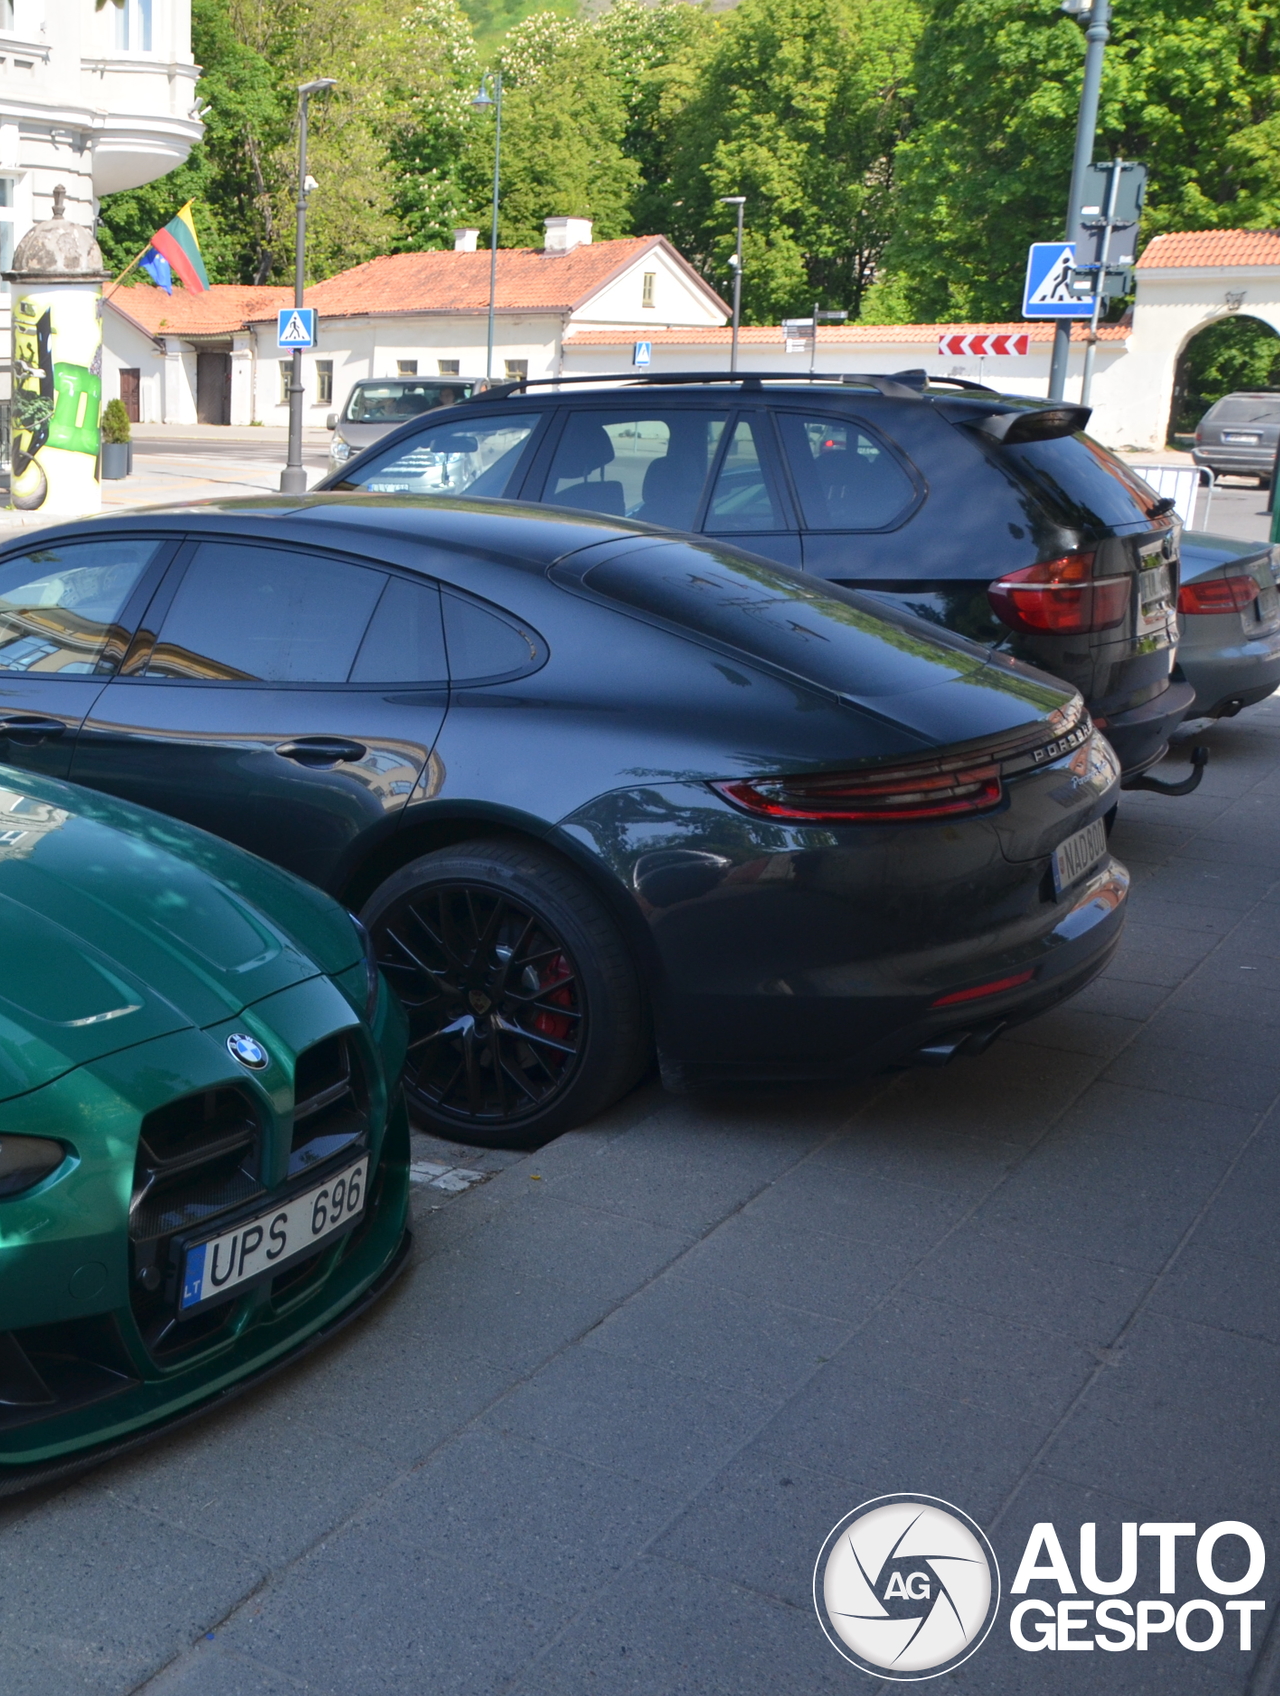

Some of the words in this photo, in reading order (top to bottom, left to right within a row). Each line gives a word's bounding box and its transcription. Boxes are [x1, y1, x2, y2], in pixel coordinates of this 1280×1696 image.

[183, 1279, 201, 1299] LT
[210, 1212, 288, 1287] UPS
[311, 1167, 362, 1235] 696
